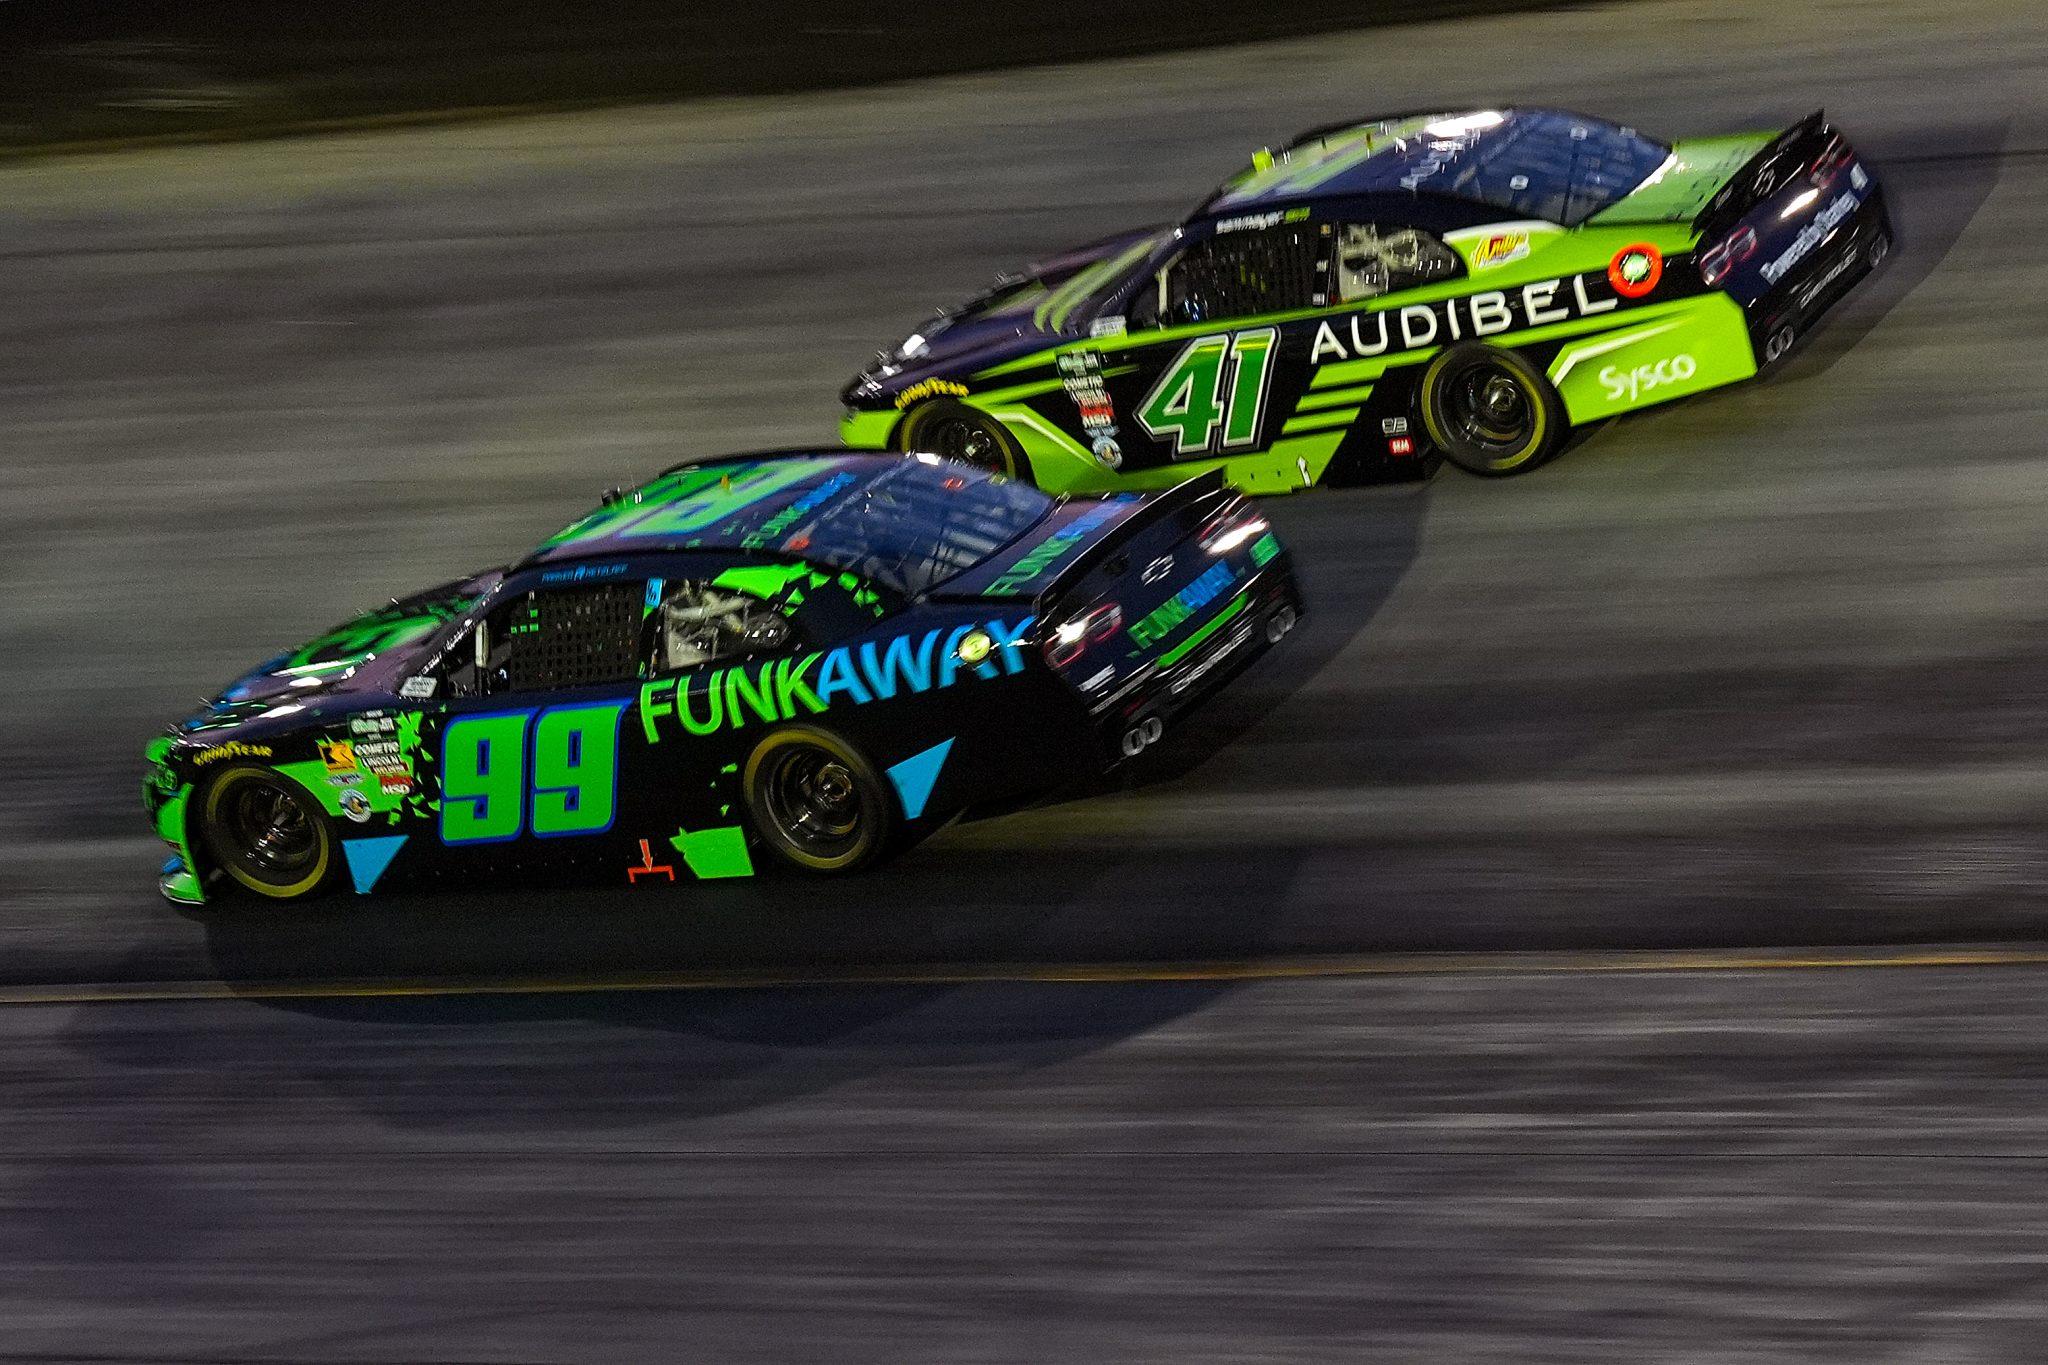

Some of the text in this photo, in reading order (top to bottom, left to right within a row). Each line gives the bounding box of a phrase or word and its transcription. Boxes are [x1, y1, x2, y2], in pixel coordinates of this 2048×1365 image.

[1309, 273, 1618, 364] AUDIBEL
[1599, 354, 1697, 402] Sysco
[1135, 325, 1281, 460] 41
[639, 615, 1039, 744] FUNKAWAY
[439, 699, 635, 847] 99
